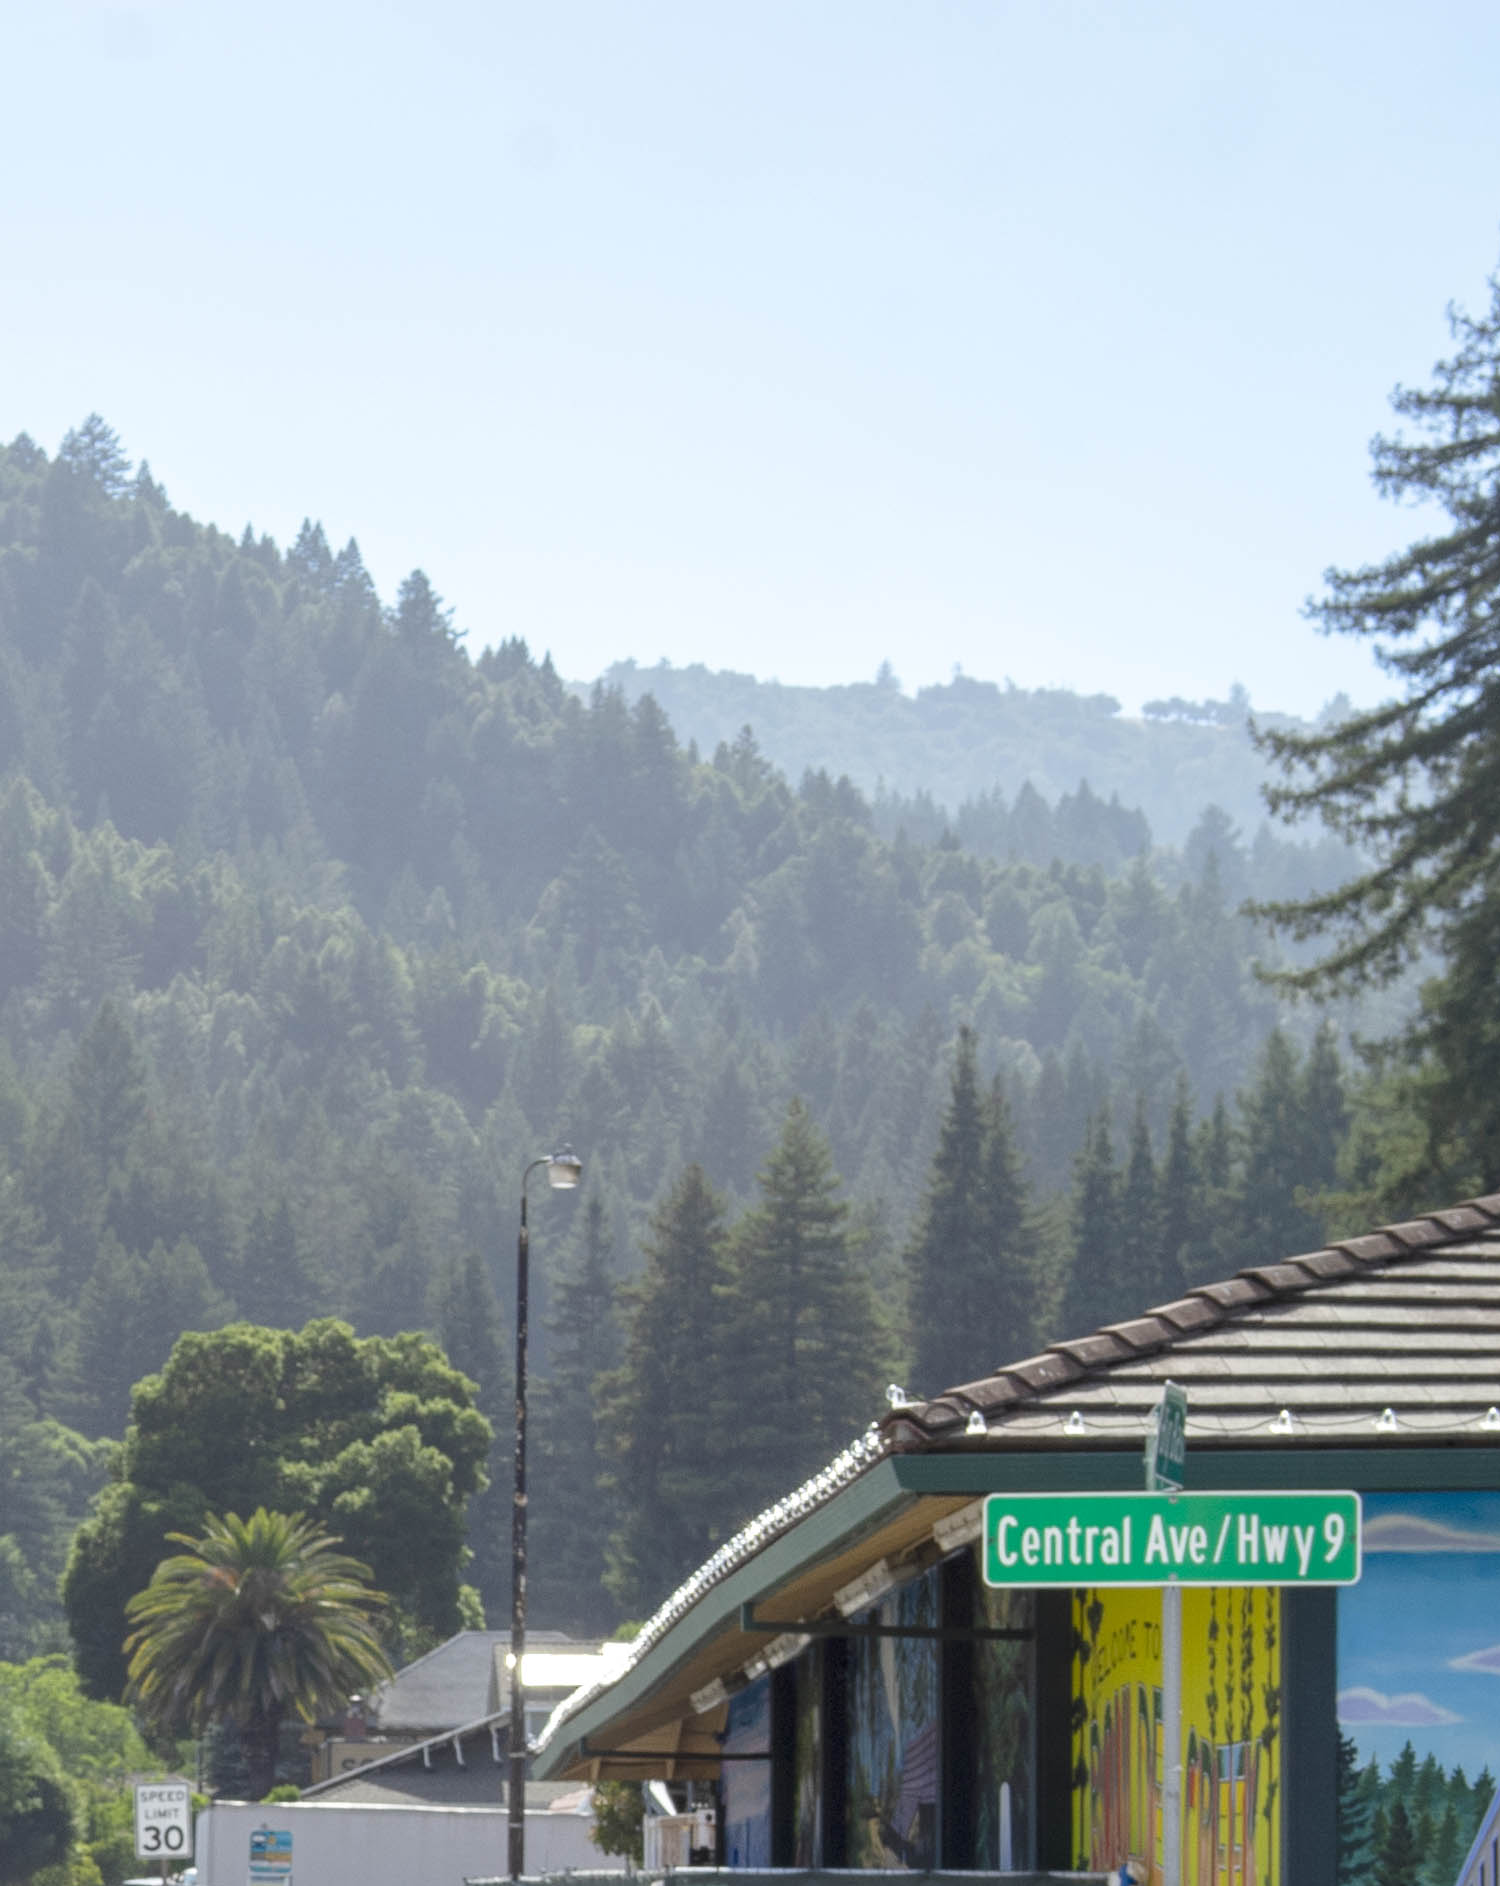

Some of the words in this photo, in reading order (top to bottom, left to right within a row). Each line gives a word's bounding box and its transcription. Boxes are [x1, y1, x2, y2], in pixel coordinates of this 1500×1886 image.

[997, 1514, 1132, 1567] Central
[1144, 1513, 1315, 1577] Ave/Hwy
[1323, 1512, 1345, 1564] 9
[1143, 1620, 1161, 1661] TO
[141, 1790, 185, 1802] SPEED
[144, 1808, 179, 1820] LIMIT
[143, 1825, 184, 1852] 30
